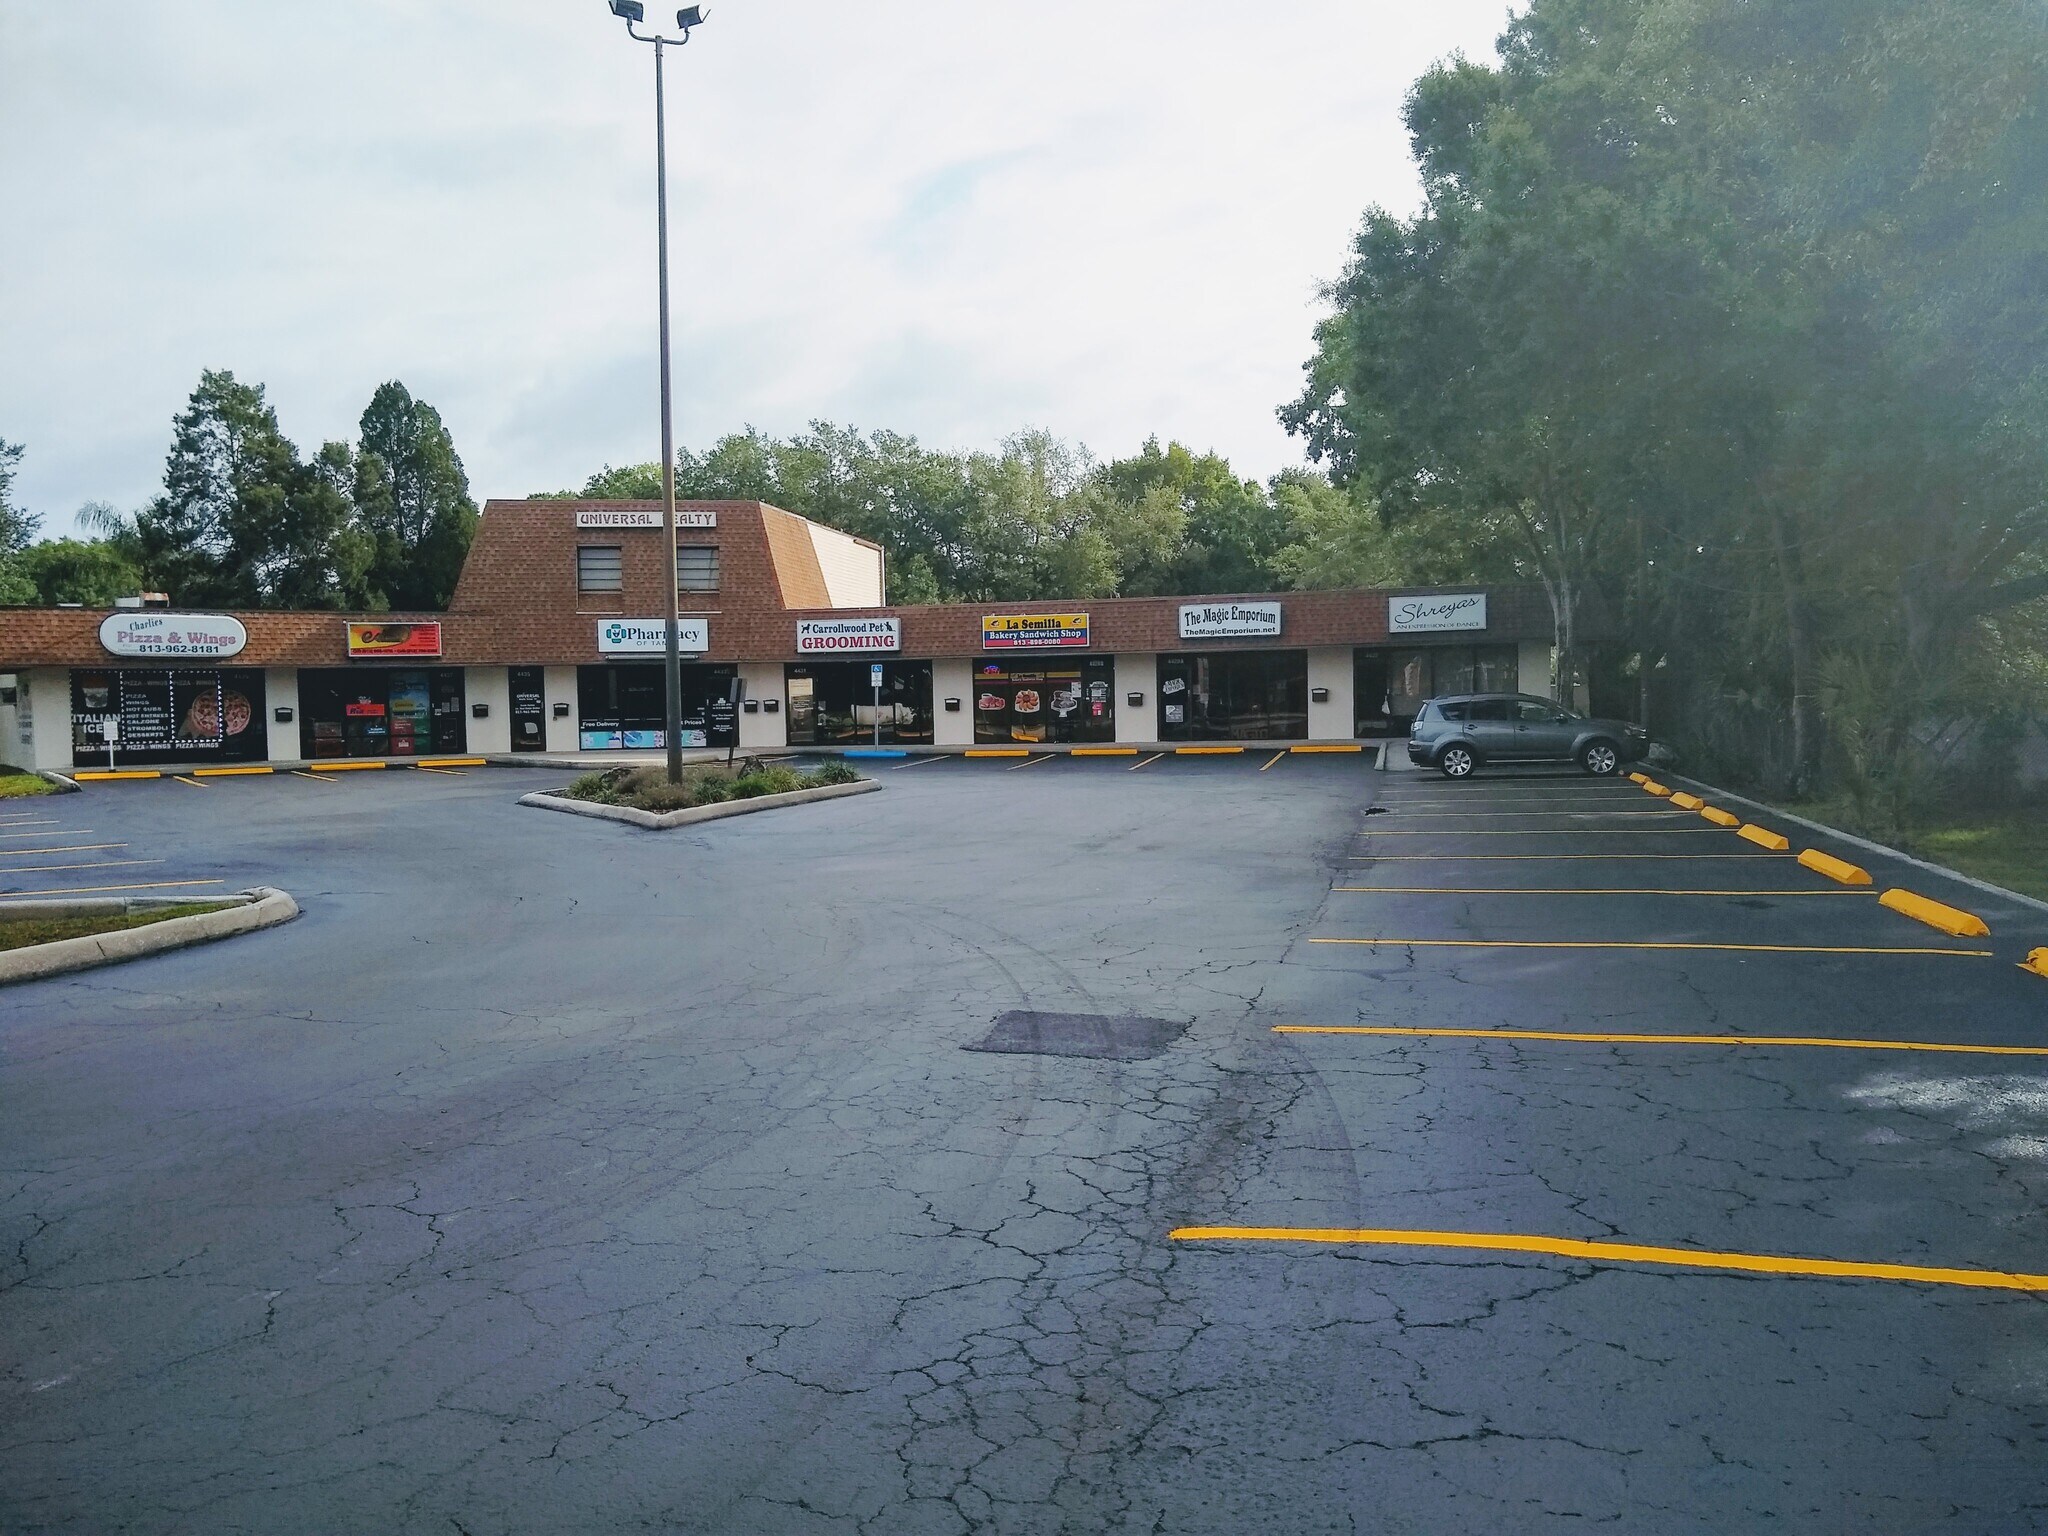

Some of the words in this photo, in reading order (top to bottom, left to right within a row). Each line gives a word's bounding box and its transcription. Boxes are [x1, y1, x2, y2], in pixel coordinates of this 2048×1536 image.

[580, 514, 653, 525] UNIVERSAL
[661, 514, 713, 526] ALTY
[1184, 611, 1201, 627] The
[1202, 607, 1229, 625] Magic
[1231, 605, 1277, 624] Emporium
[1394, 597, 1481, 624] Shreyas
[129, 617, 163, 632] Charlies
[812, 622, 867, 635] Carrollwood
[869, 622, 884, 633] Pet
[1006, 619, 1020, 630] La
[1021, 618, 1062, 630] Semilla
[989, 631, 1019, 640] Bakery
[1019, 630, 1060, 639] Sandwich
[1060, 629, 1082, 639] Shop
[1184, 627, 1277, 636] TheMagicEmporium.net
[117, 631, 163, 644] Pizza
[167, 631, 182, 644] &
[187, 631, 237, 647] Wings
[801, 635, 895, 650] GROOMING
[139, 644, 220, 654] 813-962-8181
[73, 713, 121, 723] ITALIAN
[596, 721, 620, 729] Delivery
